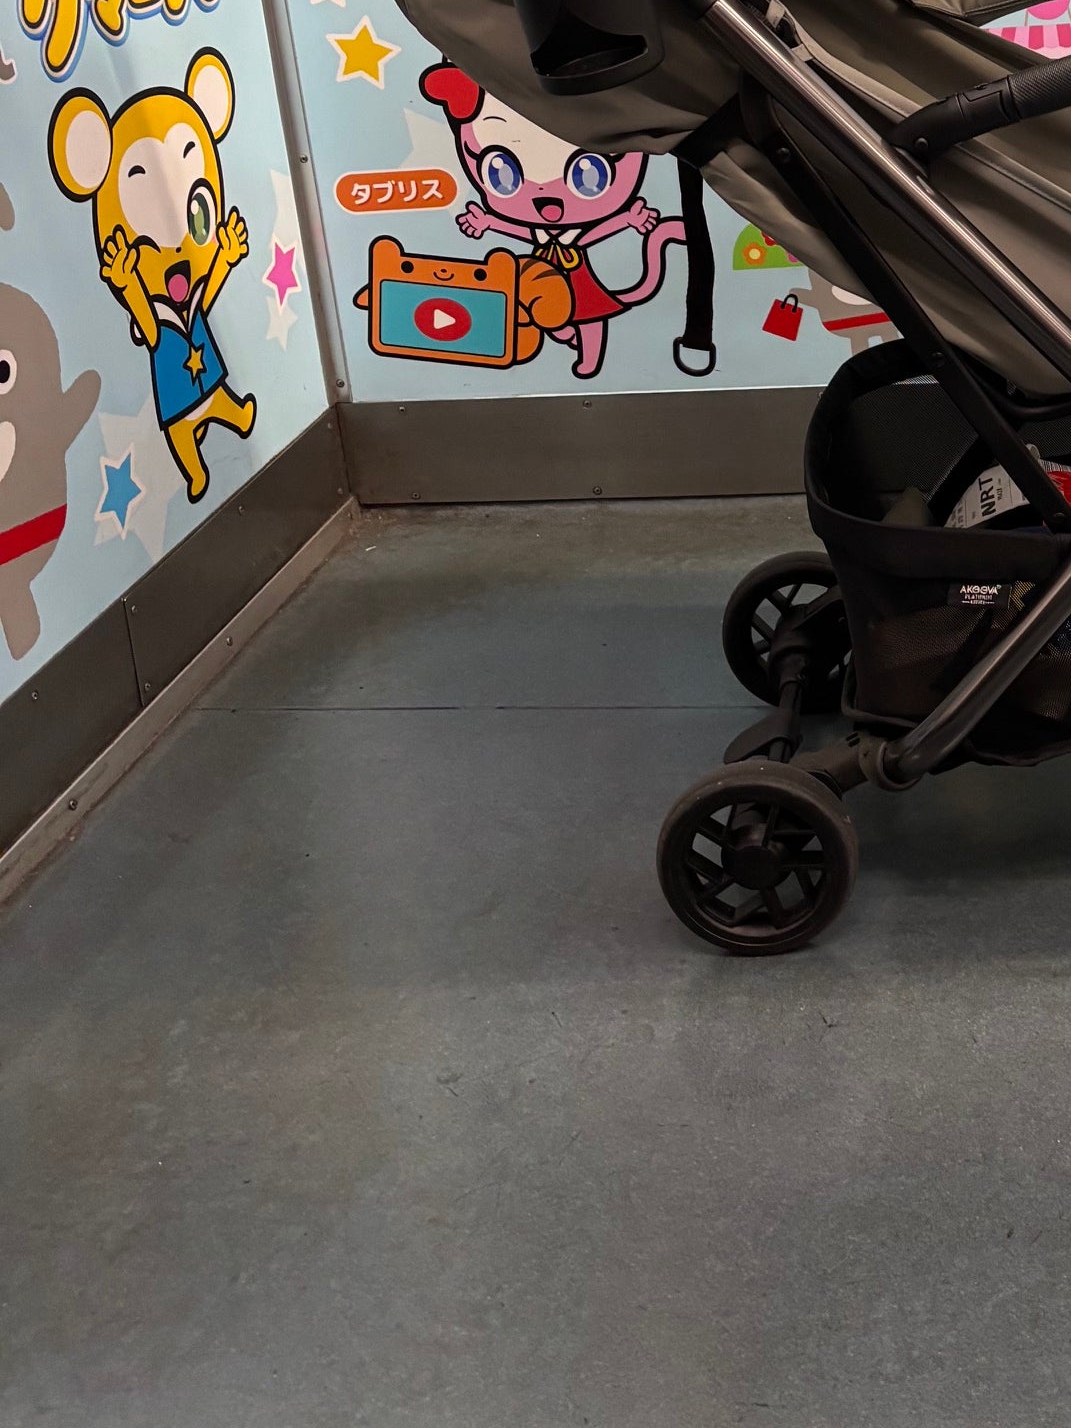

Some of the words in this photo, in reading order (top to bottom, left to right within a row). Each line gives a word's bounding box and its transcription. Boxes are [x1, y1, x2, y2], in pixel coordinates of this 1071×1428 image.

[351, 179, 443, 205] タブリス
[978, 476, 997, 517] NRT
